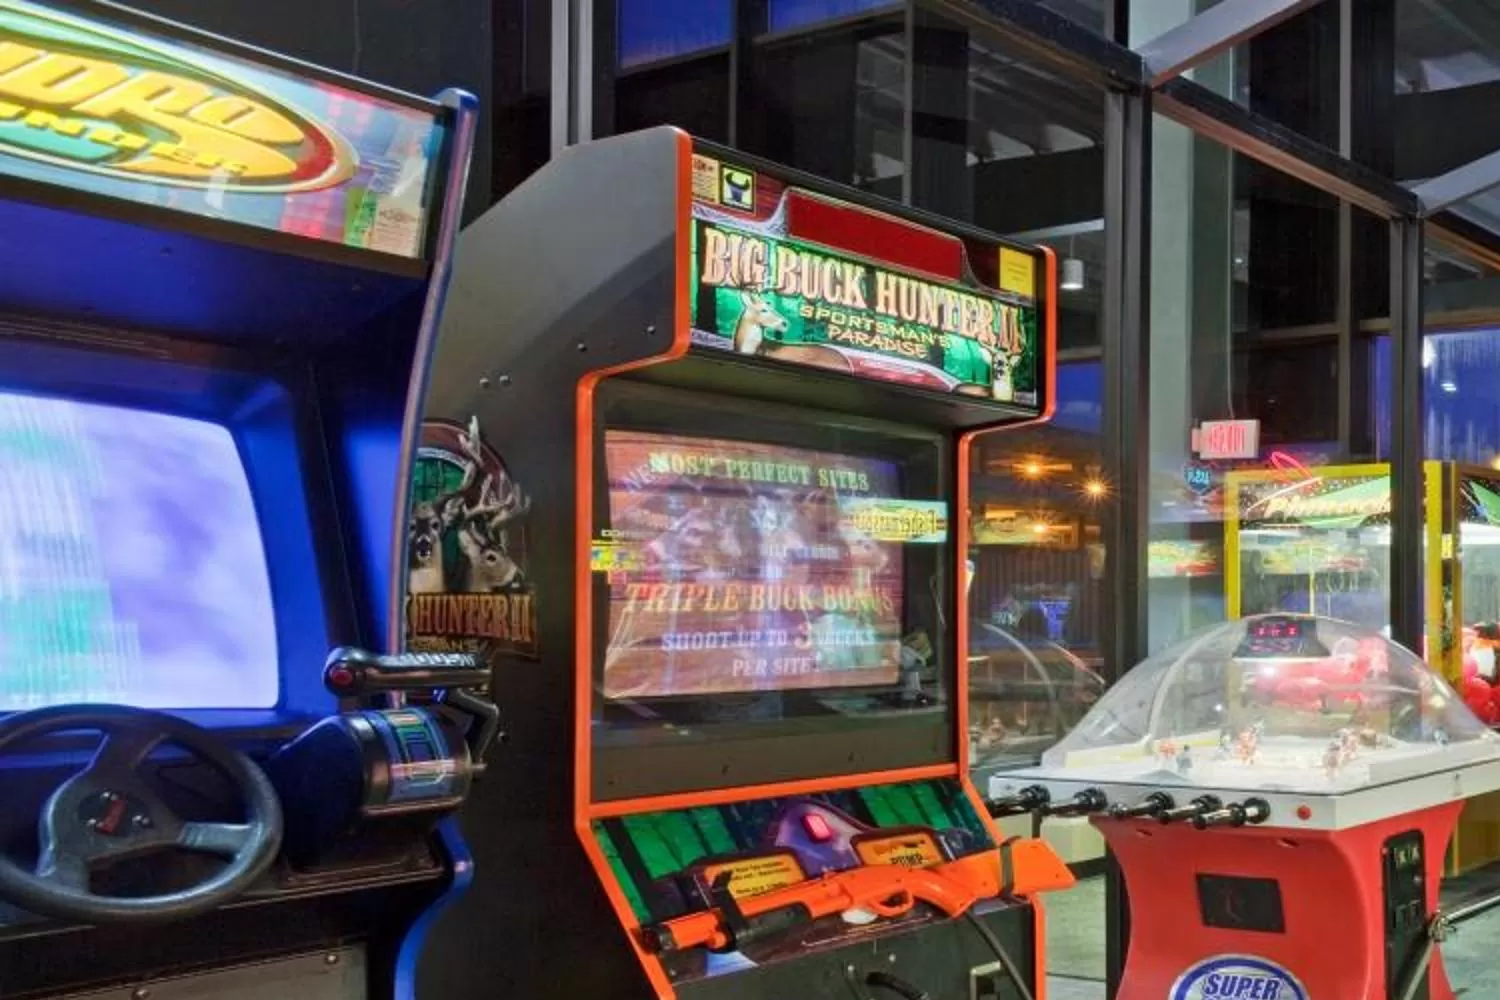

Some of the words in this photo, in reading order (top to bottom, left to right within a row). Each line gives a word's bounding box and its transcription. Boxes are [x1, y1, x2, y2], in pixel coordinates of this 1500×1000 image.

[701, 227, 768, 286] BIG
[776, 245, 867, 308] BUCK
[876, 270, 996, 349] HUNTER
[800, 304, 952, 348] SPORTSMAN'S
[827, 324, 929, 358] PARADISE
[649, 452, 713, 477] MOST
[725, 459, 810, 487] PERFECT
[818, 467, 870, 492] SITES
[624, 582, 741, 614] TRIPLE
[749, 583, 817, 613] BUCK
[416, 594, 509, 641] HUNTER
[660, 631, 732, 651] SHOOT
[765, 630, 788, 648] TO
[732, 658, 768, 677] PER
[1203, 973, 1280, 1000] SUPER
